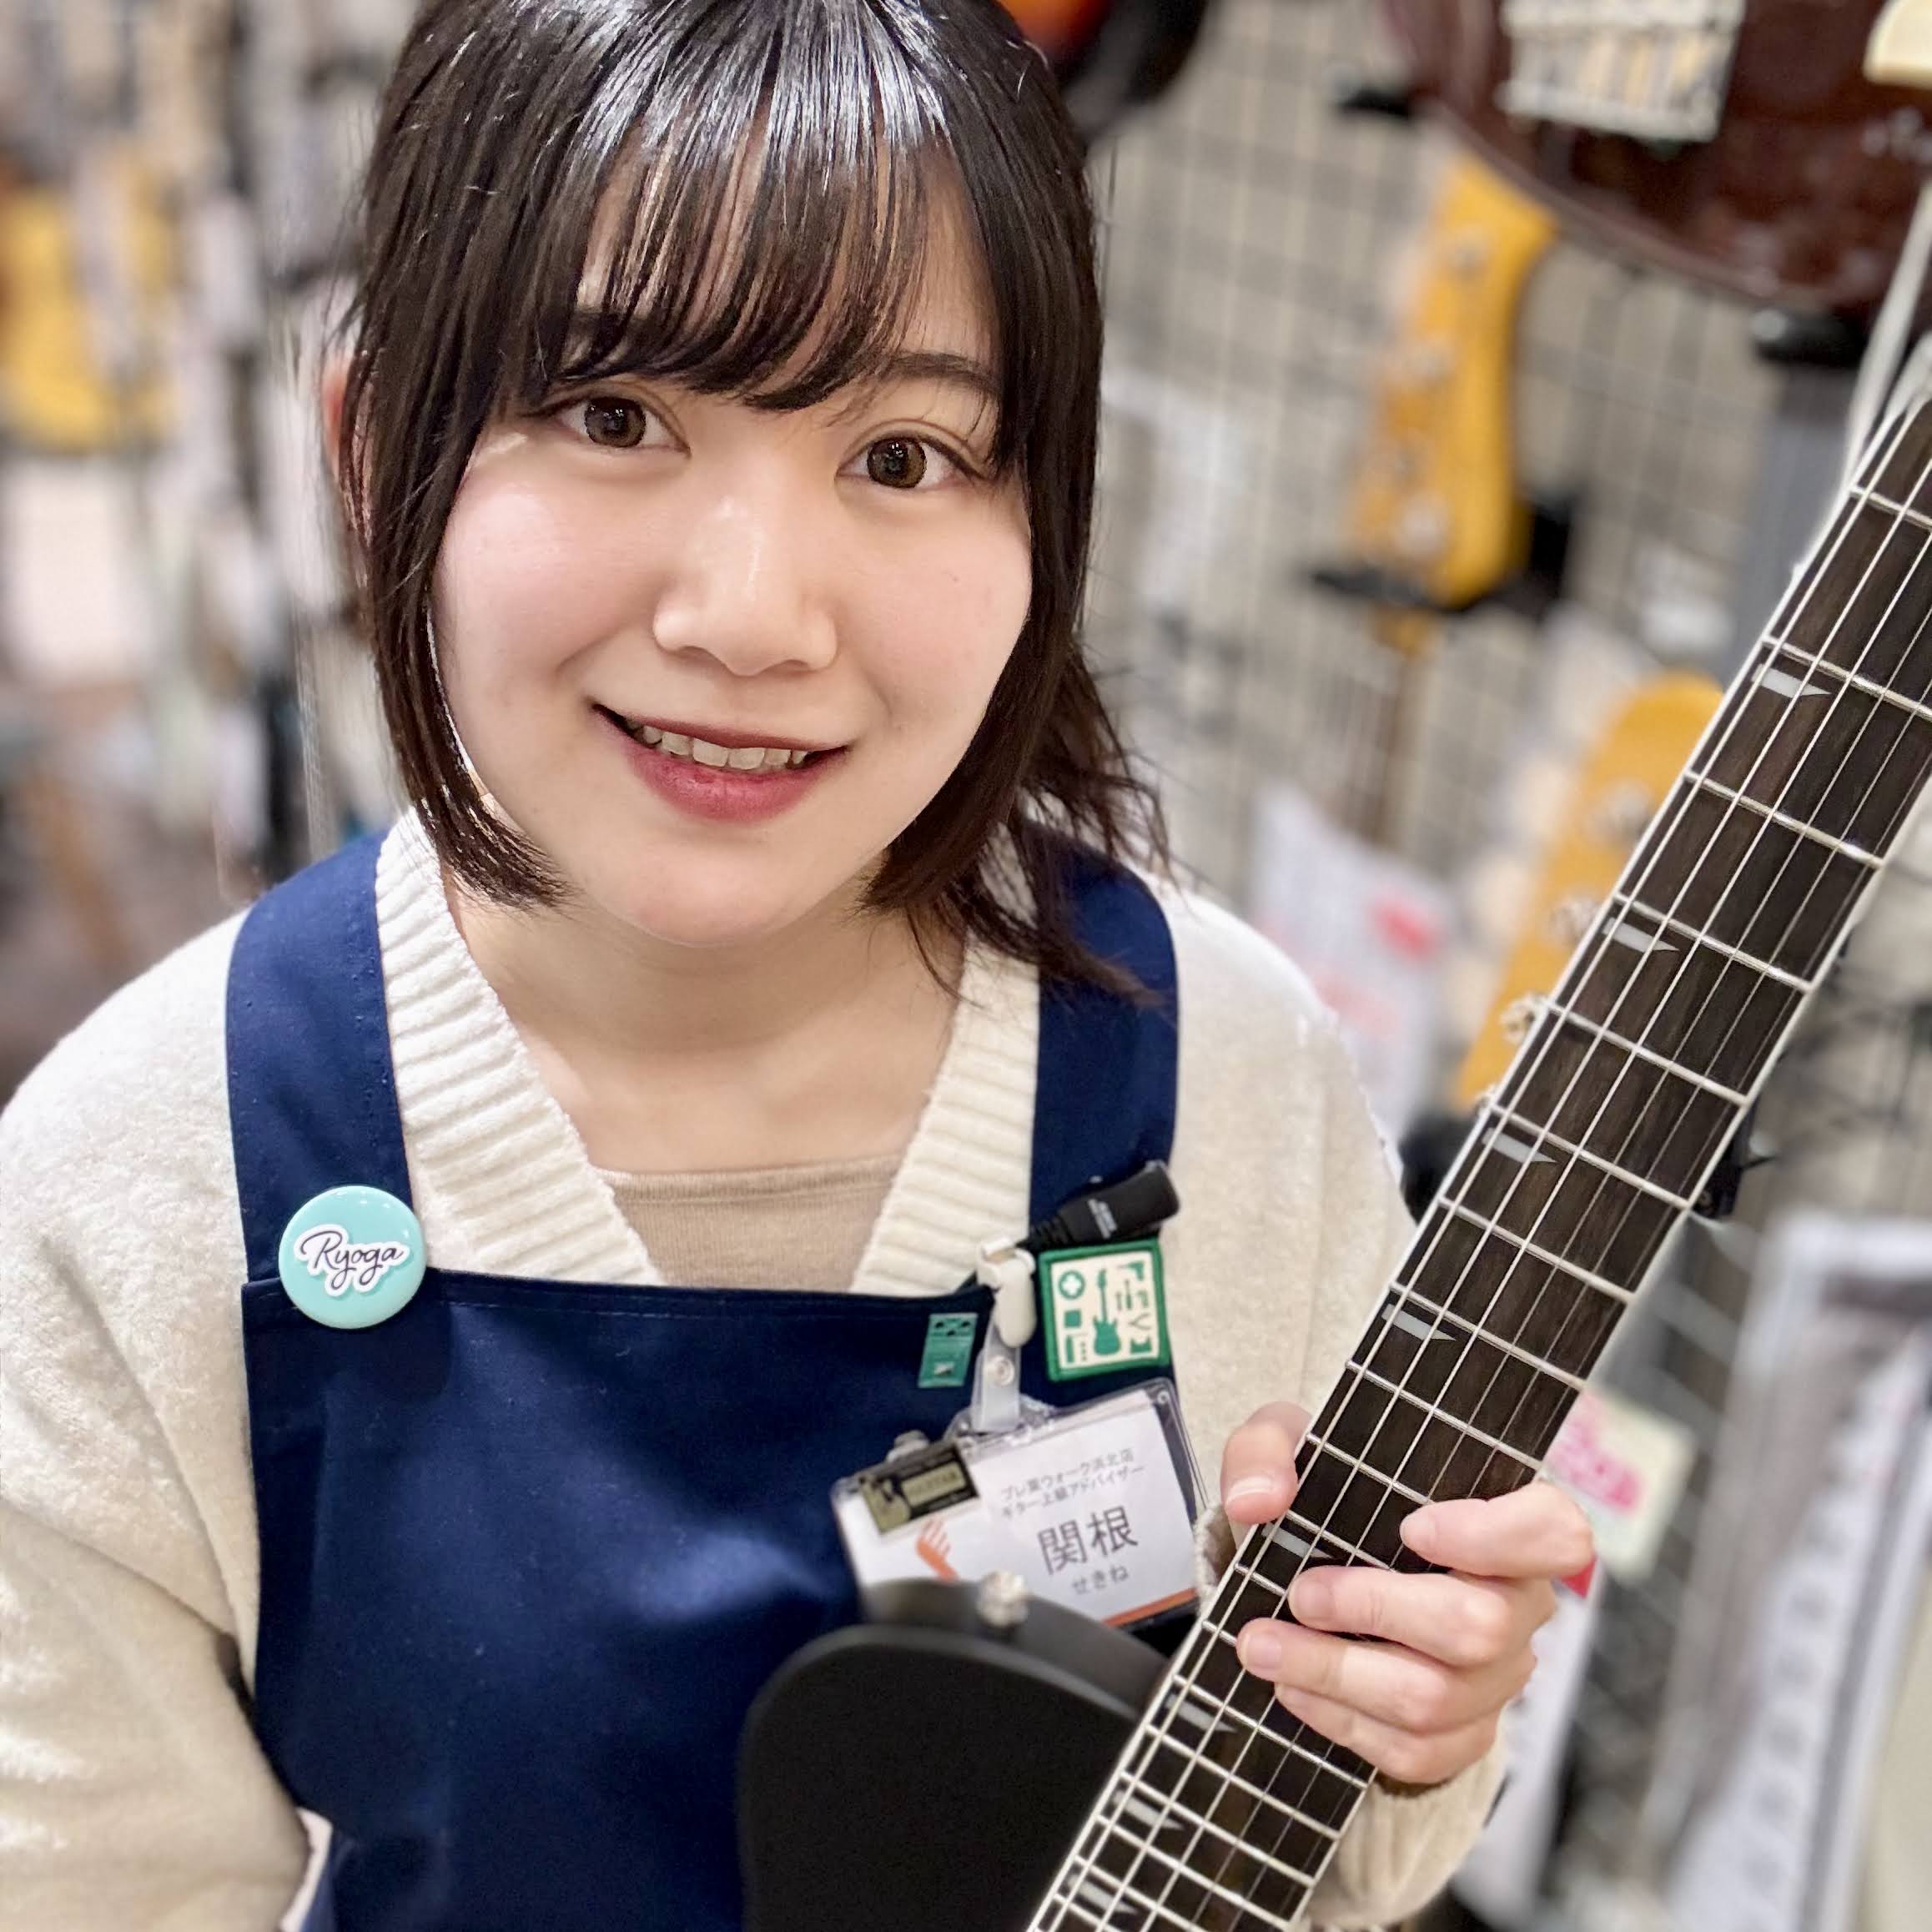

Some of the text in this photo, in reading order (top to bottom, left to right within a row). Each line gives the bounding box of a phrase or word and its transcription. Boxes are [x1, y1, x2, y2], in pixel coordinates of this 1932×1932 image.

[300, 1230, 405, 1291] Ryoga
[1037, 1505, 1139, 1576] 関根
[1072, 1565, 1130, 1595] せきね
